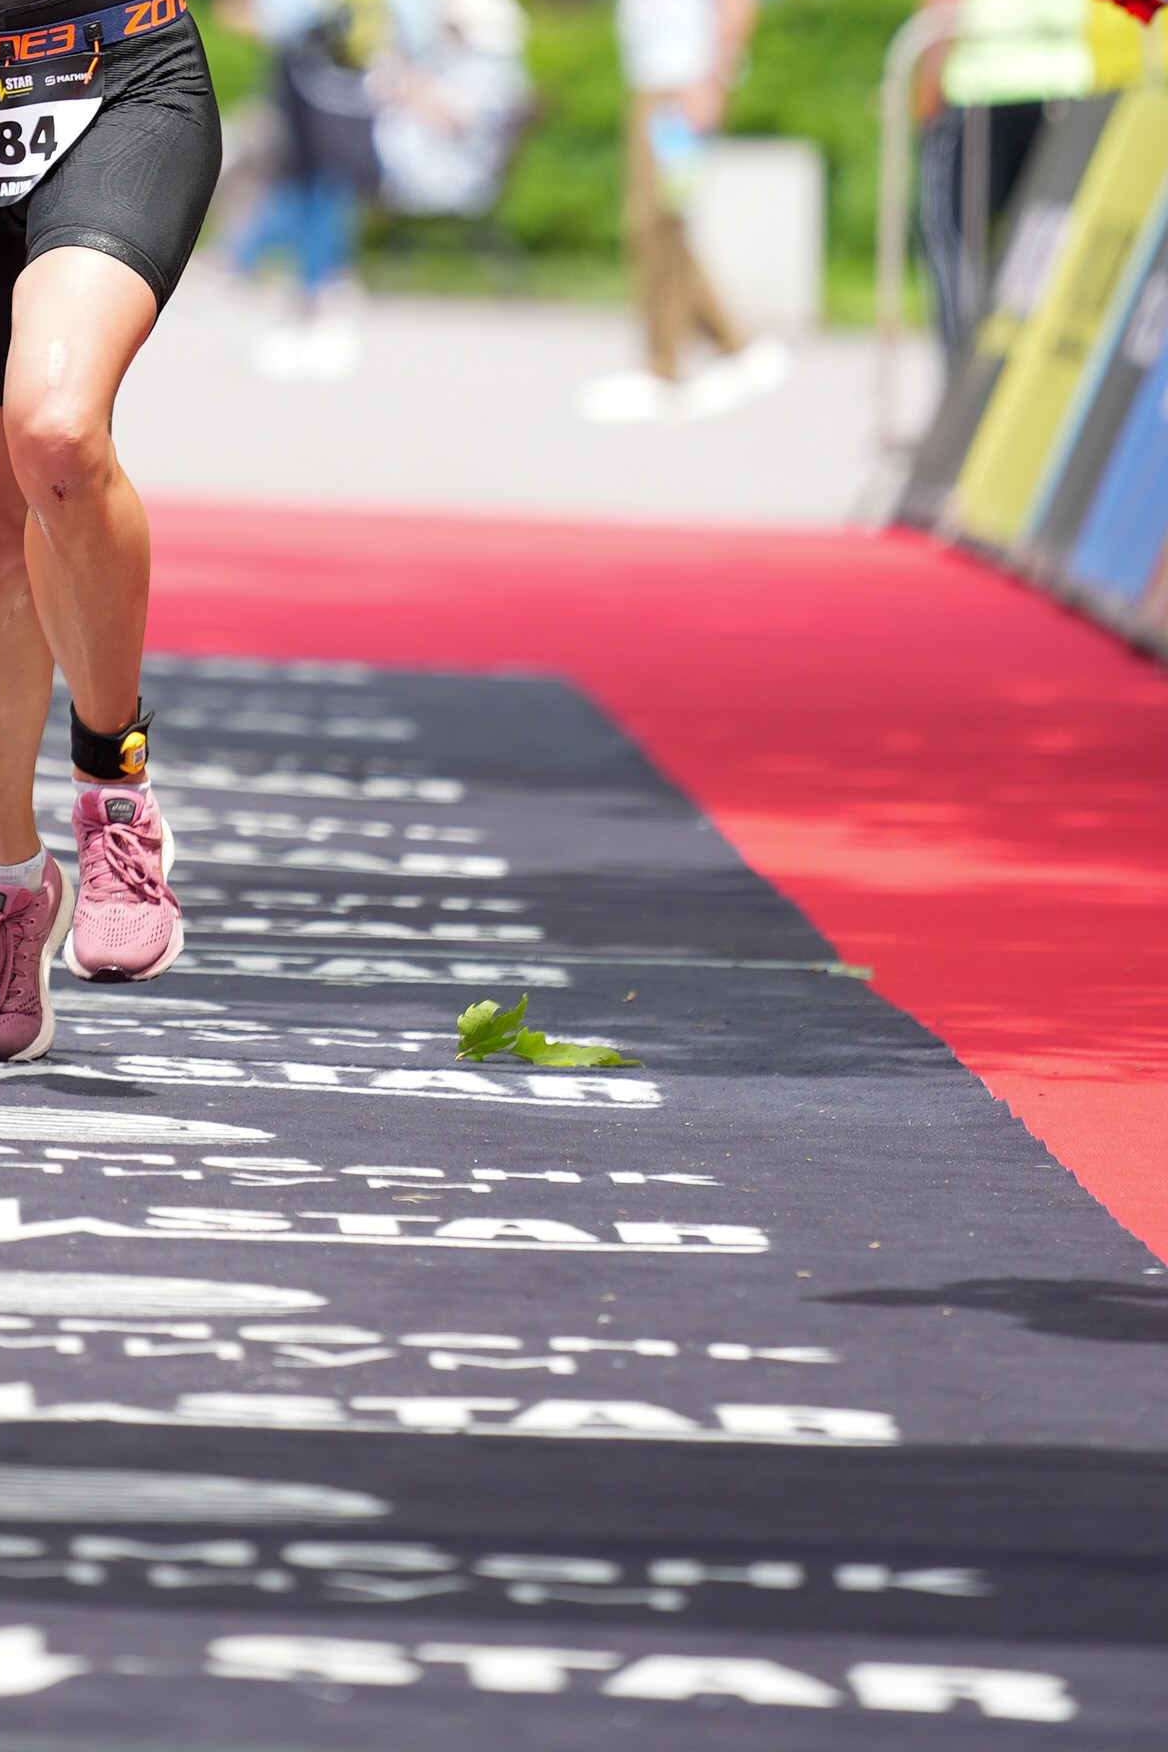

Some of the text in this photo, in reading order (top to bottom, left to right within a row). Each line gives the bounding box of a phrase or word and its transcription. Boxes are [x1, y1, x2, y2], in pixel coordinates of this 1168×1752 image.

[4, 75, 33, 90] STAR
[115, 1054, 663, 1104] STAR
[144, 1205, 770, 1249] STAR
[174, 1392, 899, 1444] STAR
[206, 1634, 1078, 1723] STAR
